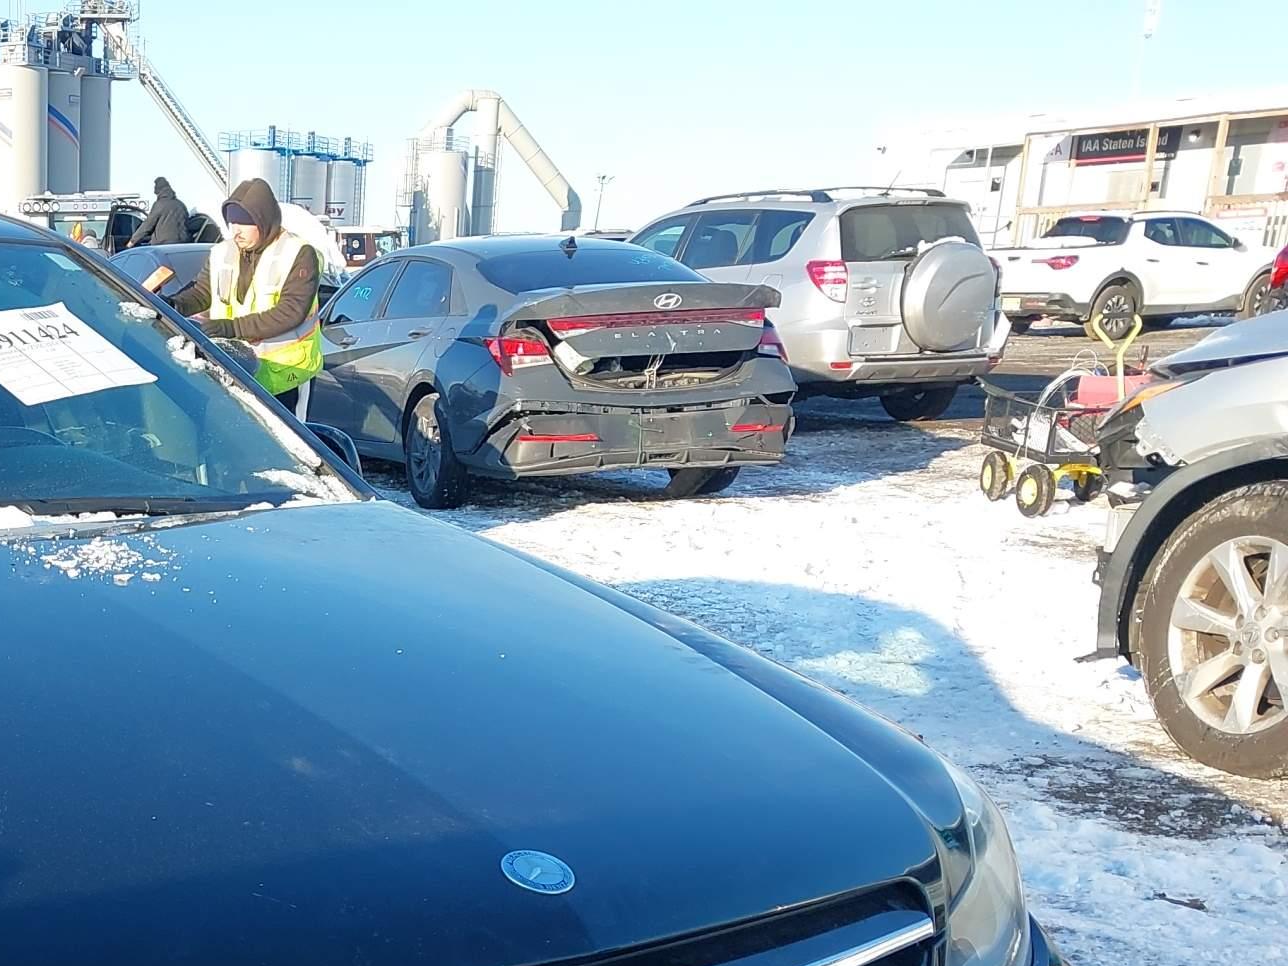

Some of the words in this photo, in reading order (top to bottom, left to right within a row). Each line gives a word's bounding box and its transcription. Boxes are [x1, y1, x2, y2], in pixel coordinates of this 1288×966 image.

[1081, 139, 1100, 152] IAA
[1102, 137, 1135, 151] Staten
[1136, 132, 1169, 148] Isld
[614, 328, 721, 339] ELATRA
